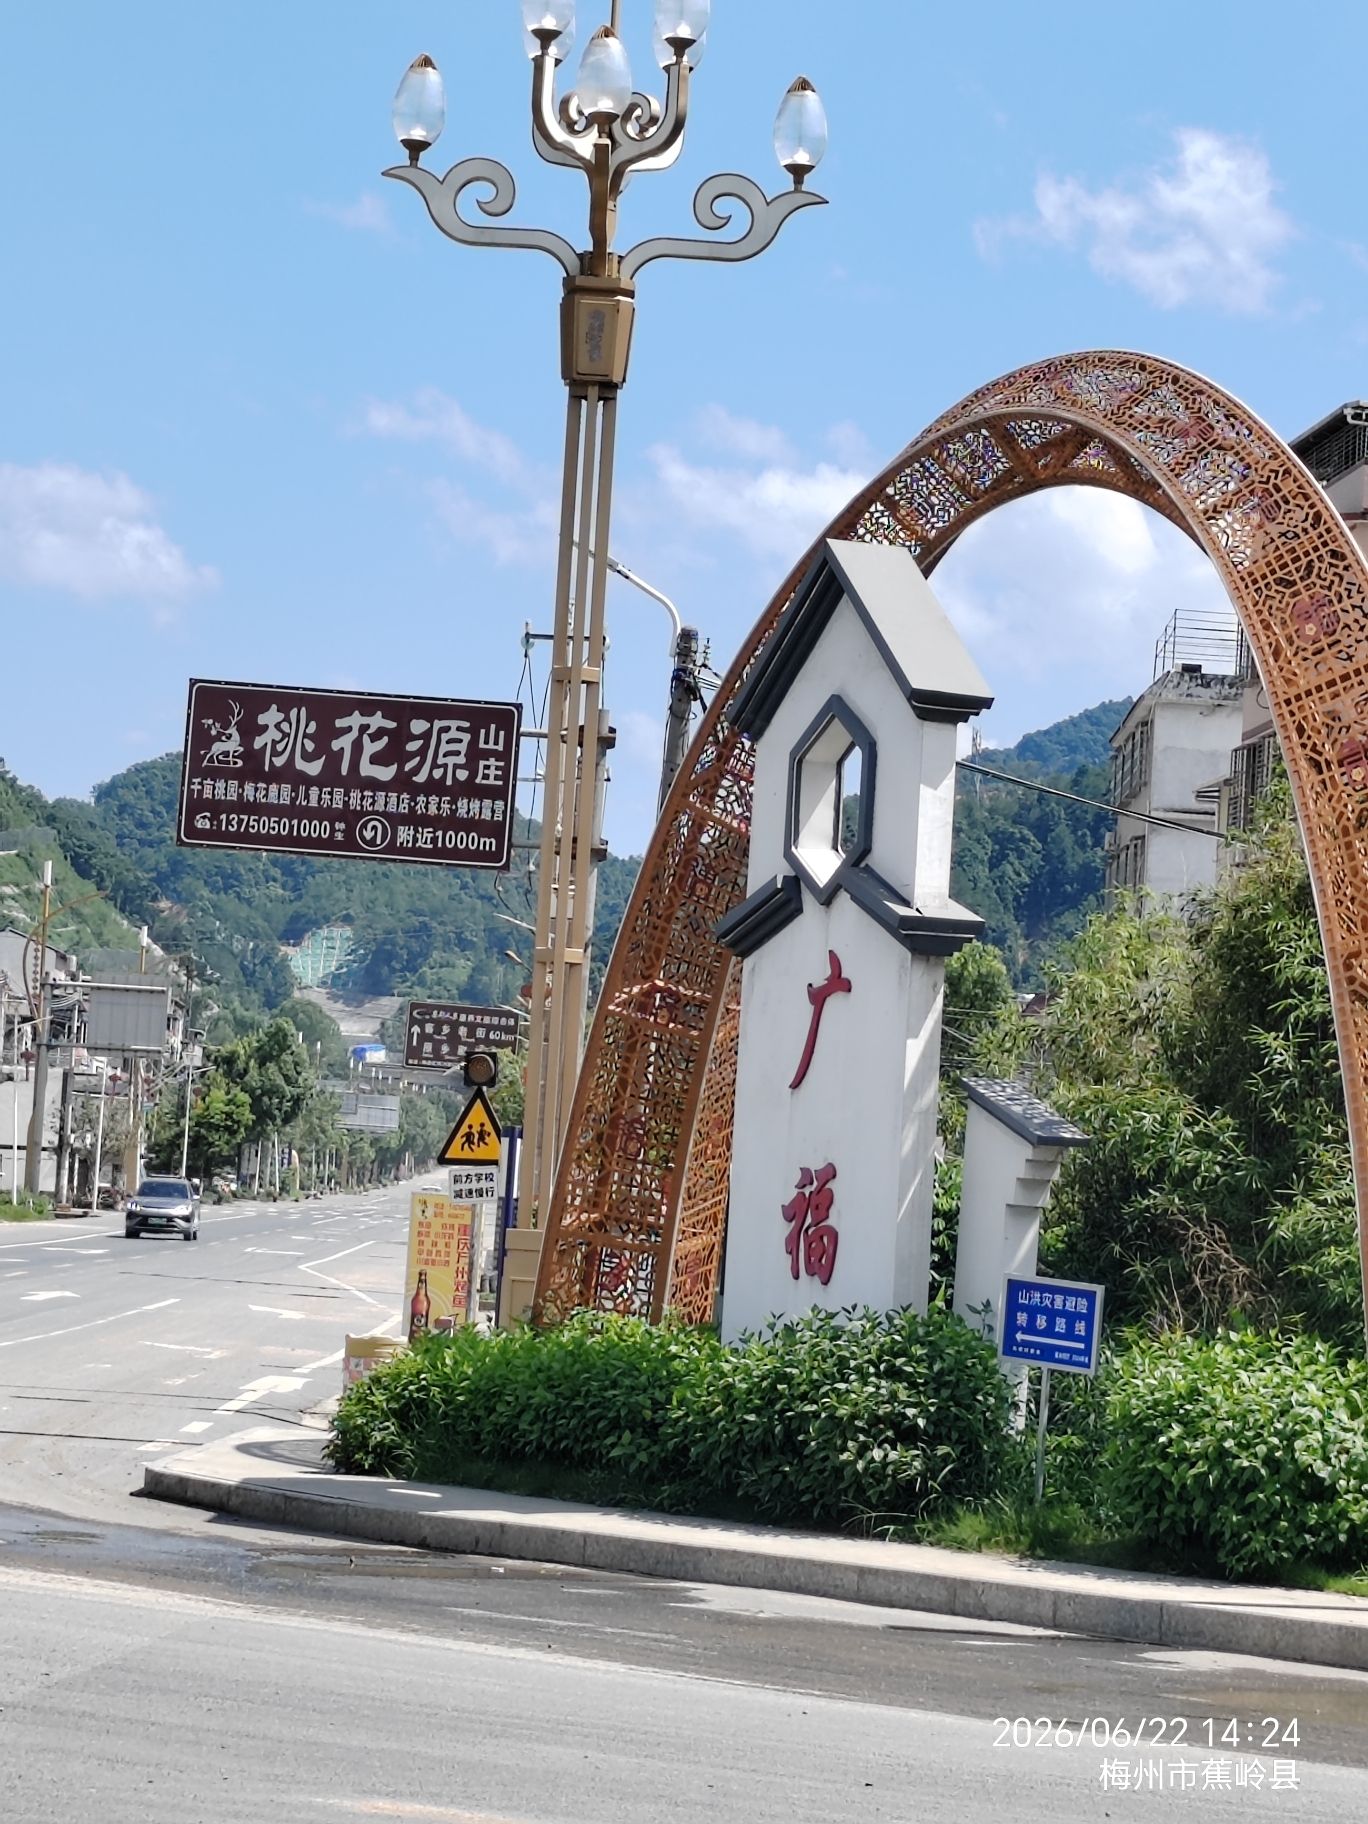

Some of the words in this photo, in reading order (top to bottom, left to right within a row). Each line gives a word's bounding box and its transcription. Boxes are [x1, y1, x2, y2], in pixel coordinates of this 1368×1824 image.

[253, 703, 472, 786] 桃花源
[475, 723, 505, 786] 山庄
[219, 813, 330, 839] 13750501000
[396, 825, 497, 851] 附近1000m
[781, 949, 853, 1286] 广福
[453, 1172, 495, 1185] 前方学校
[453, 1186, 495, 1199] 减速慢行
[1018, 1288, 1088, 1313] 山洪灾害避险
[1016, 1311, 1086, 1336] 转移路线
